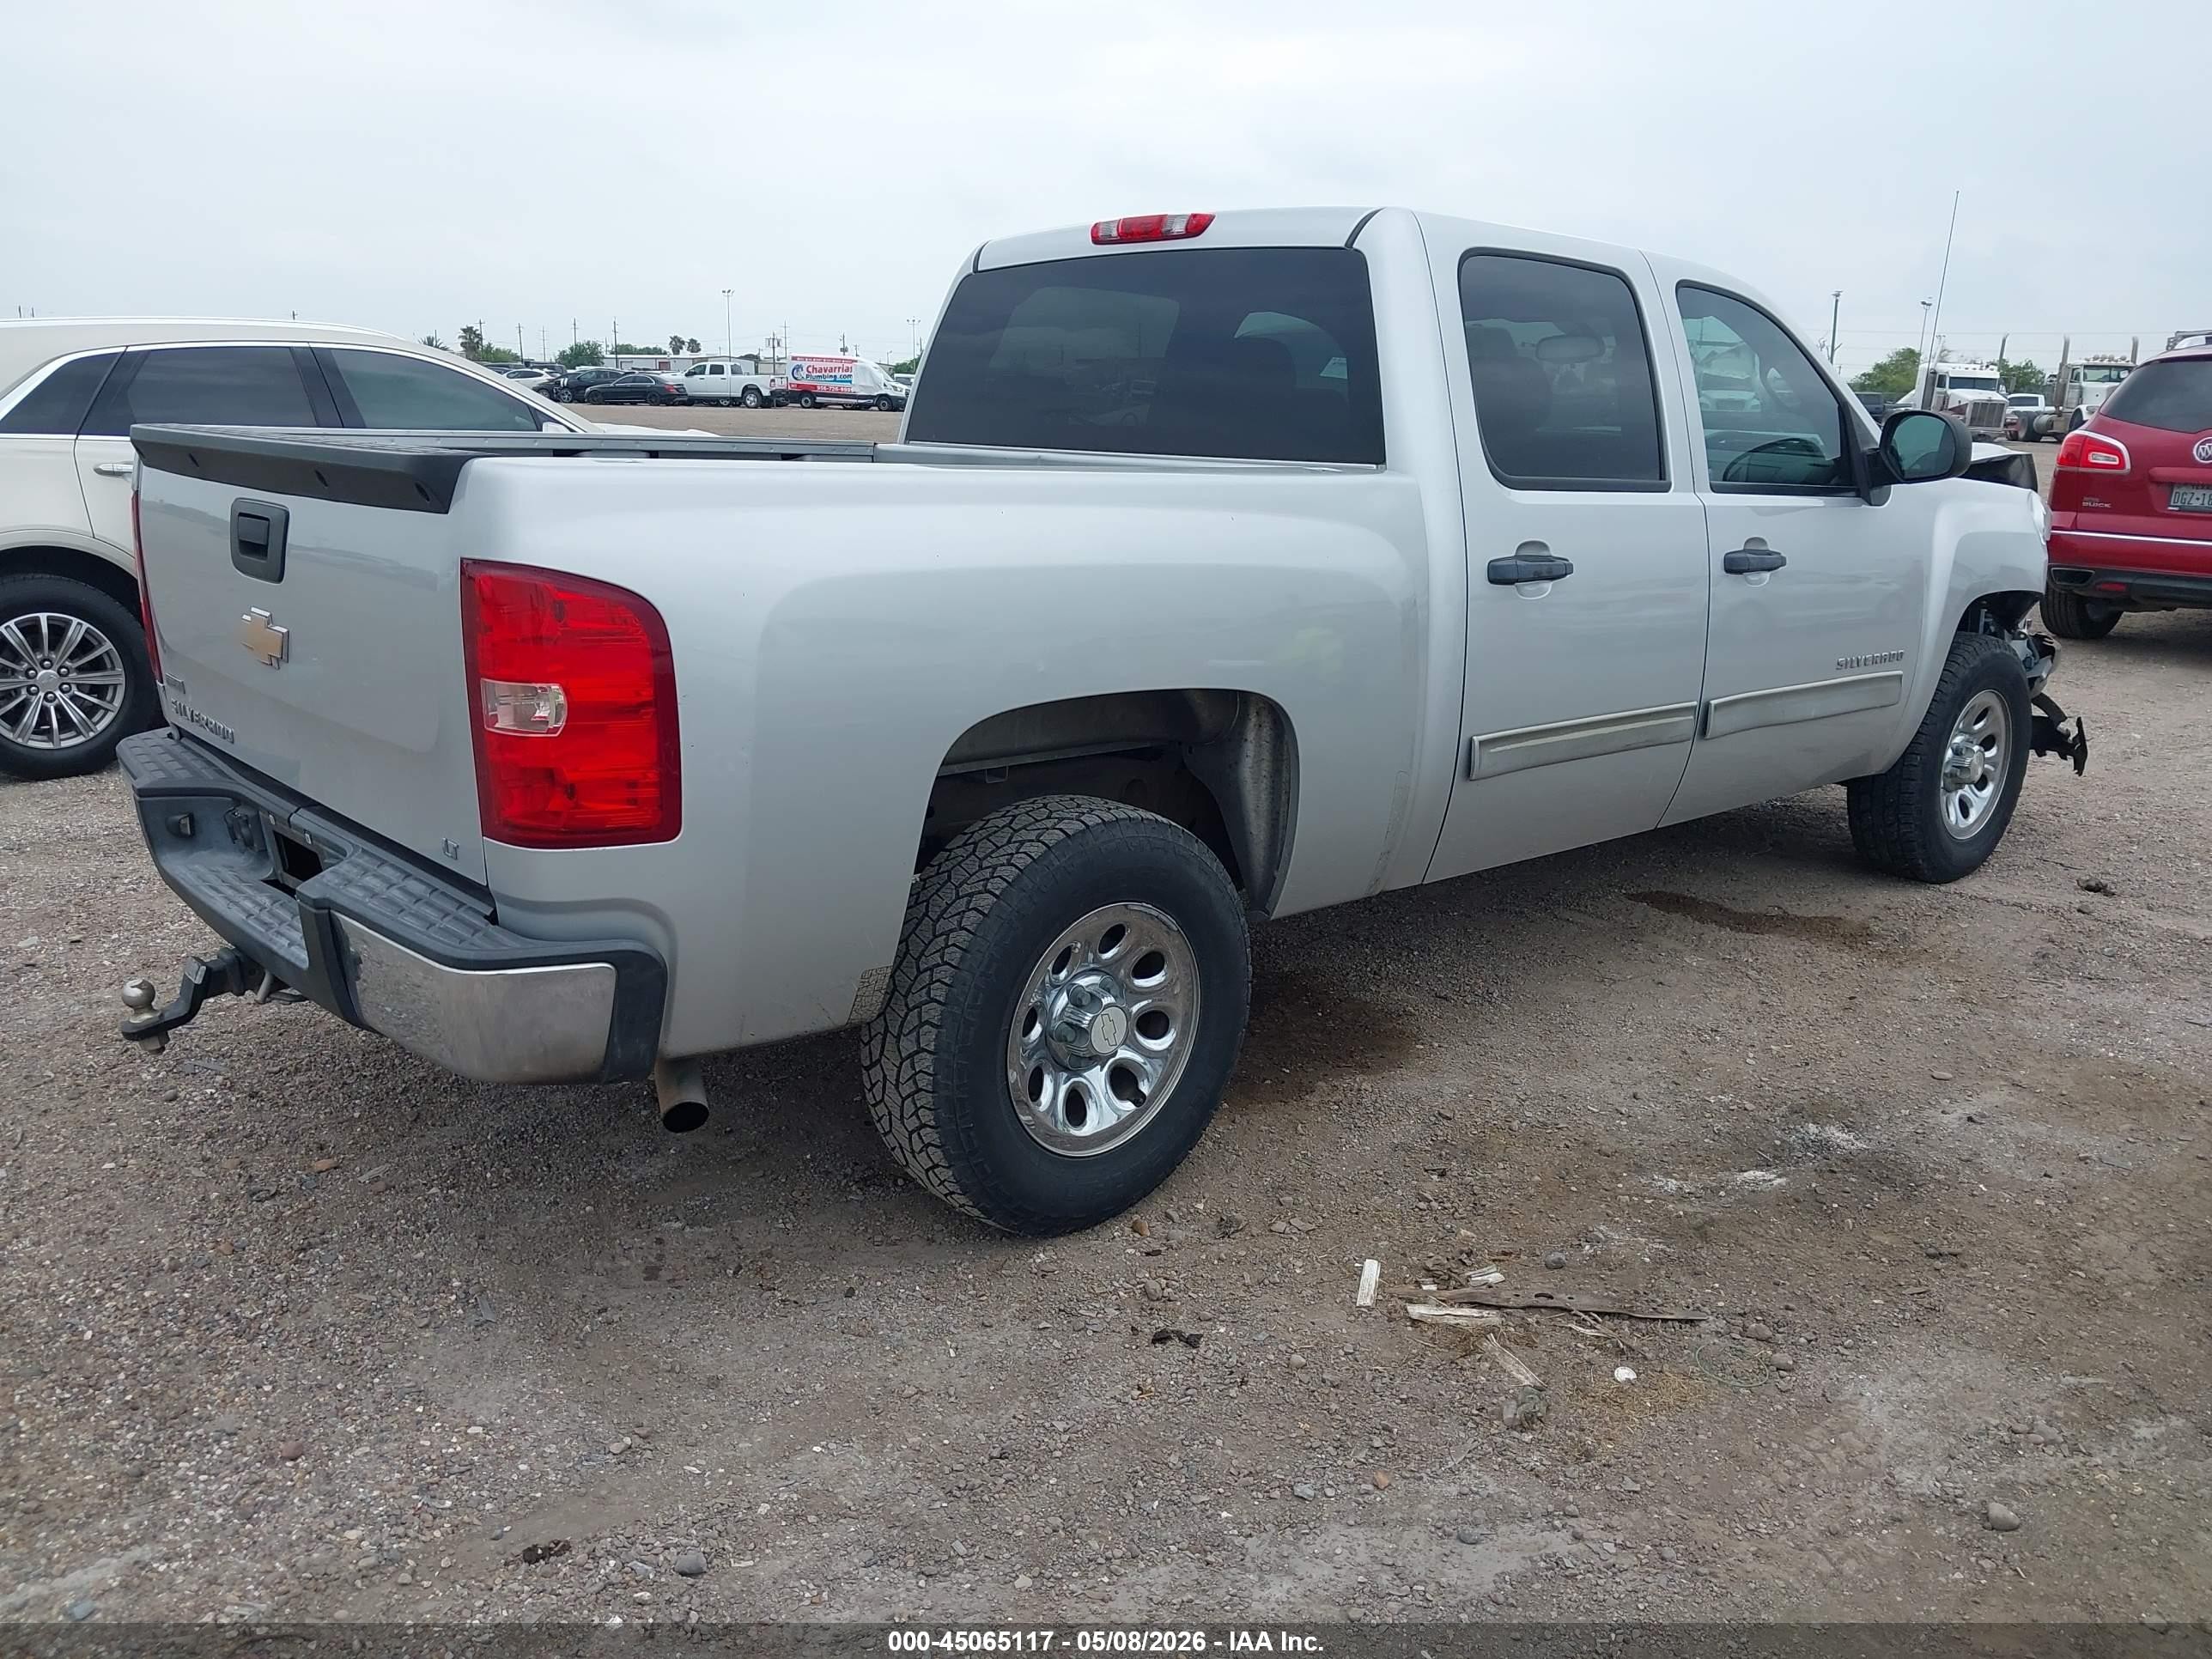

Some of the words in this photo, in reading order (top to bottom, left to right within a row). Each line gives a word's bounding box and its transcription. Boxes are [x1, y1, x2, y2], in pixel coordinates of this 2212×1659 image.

[1836, 649, 1905, 670] SILVERADO
[171, 697, 234, 744] SILVERADO
[442, 837, 459, 860] LT
